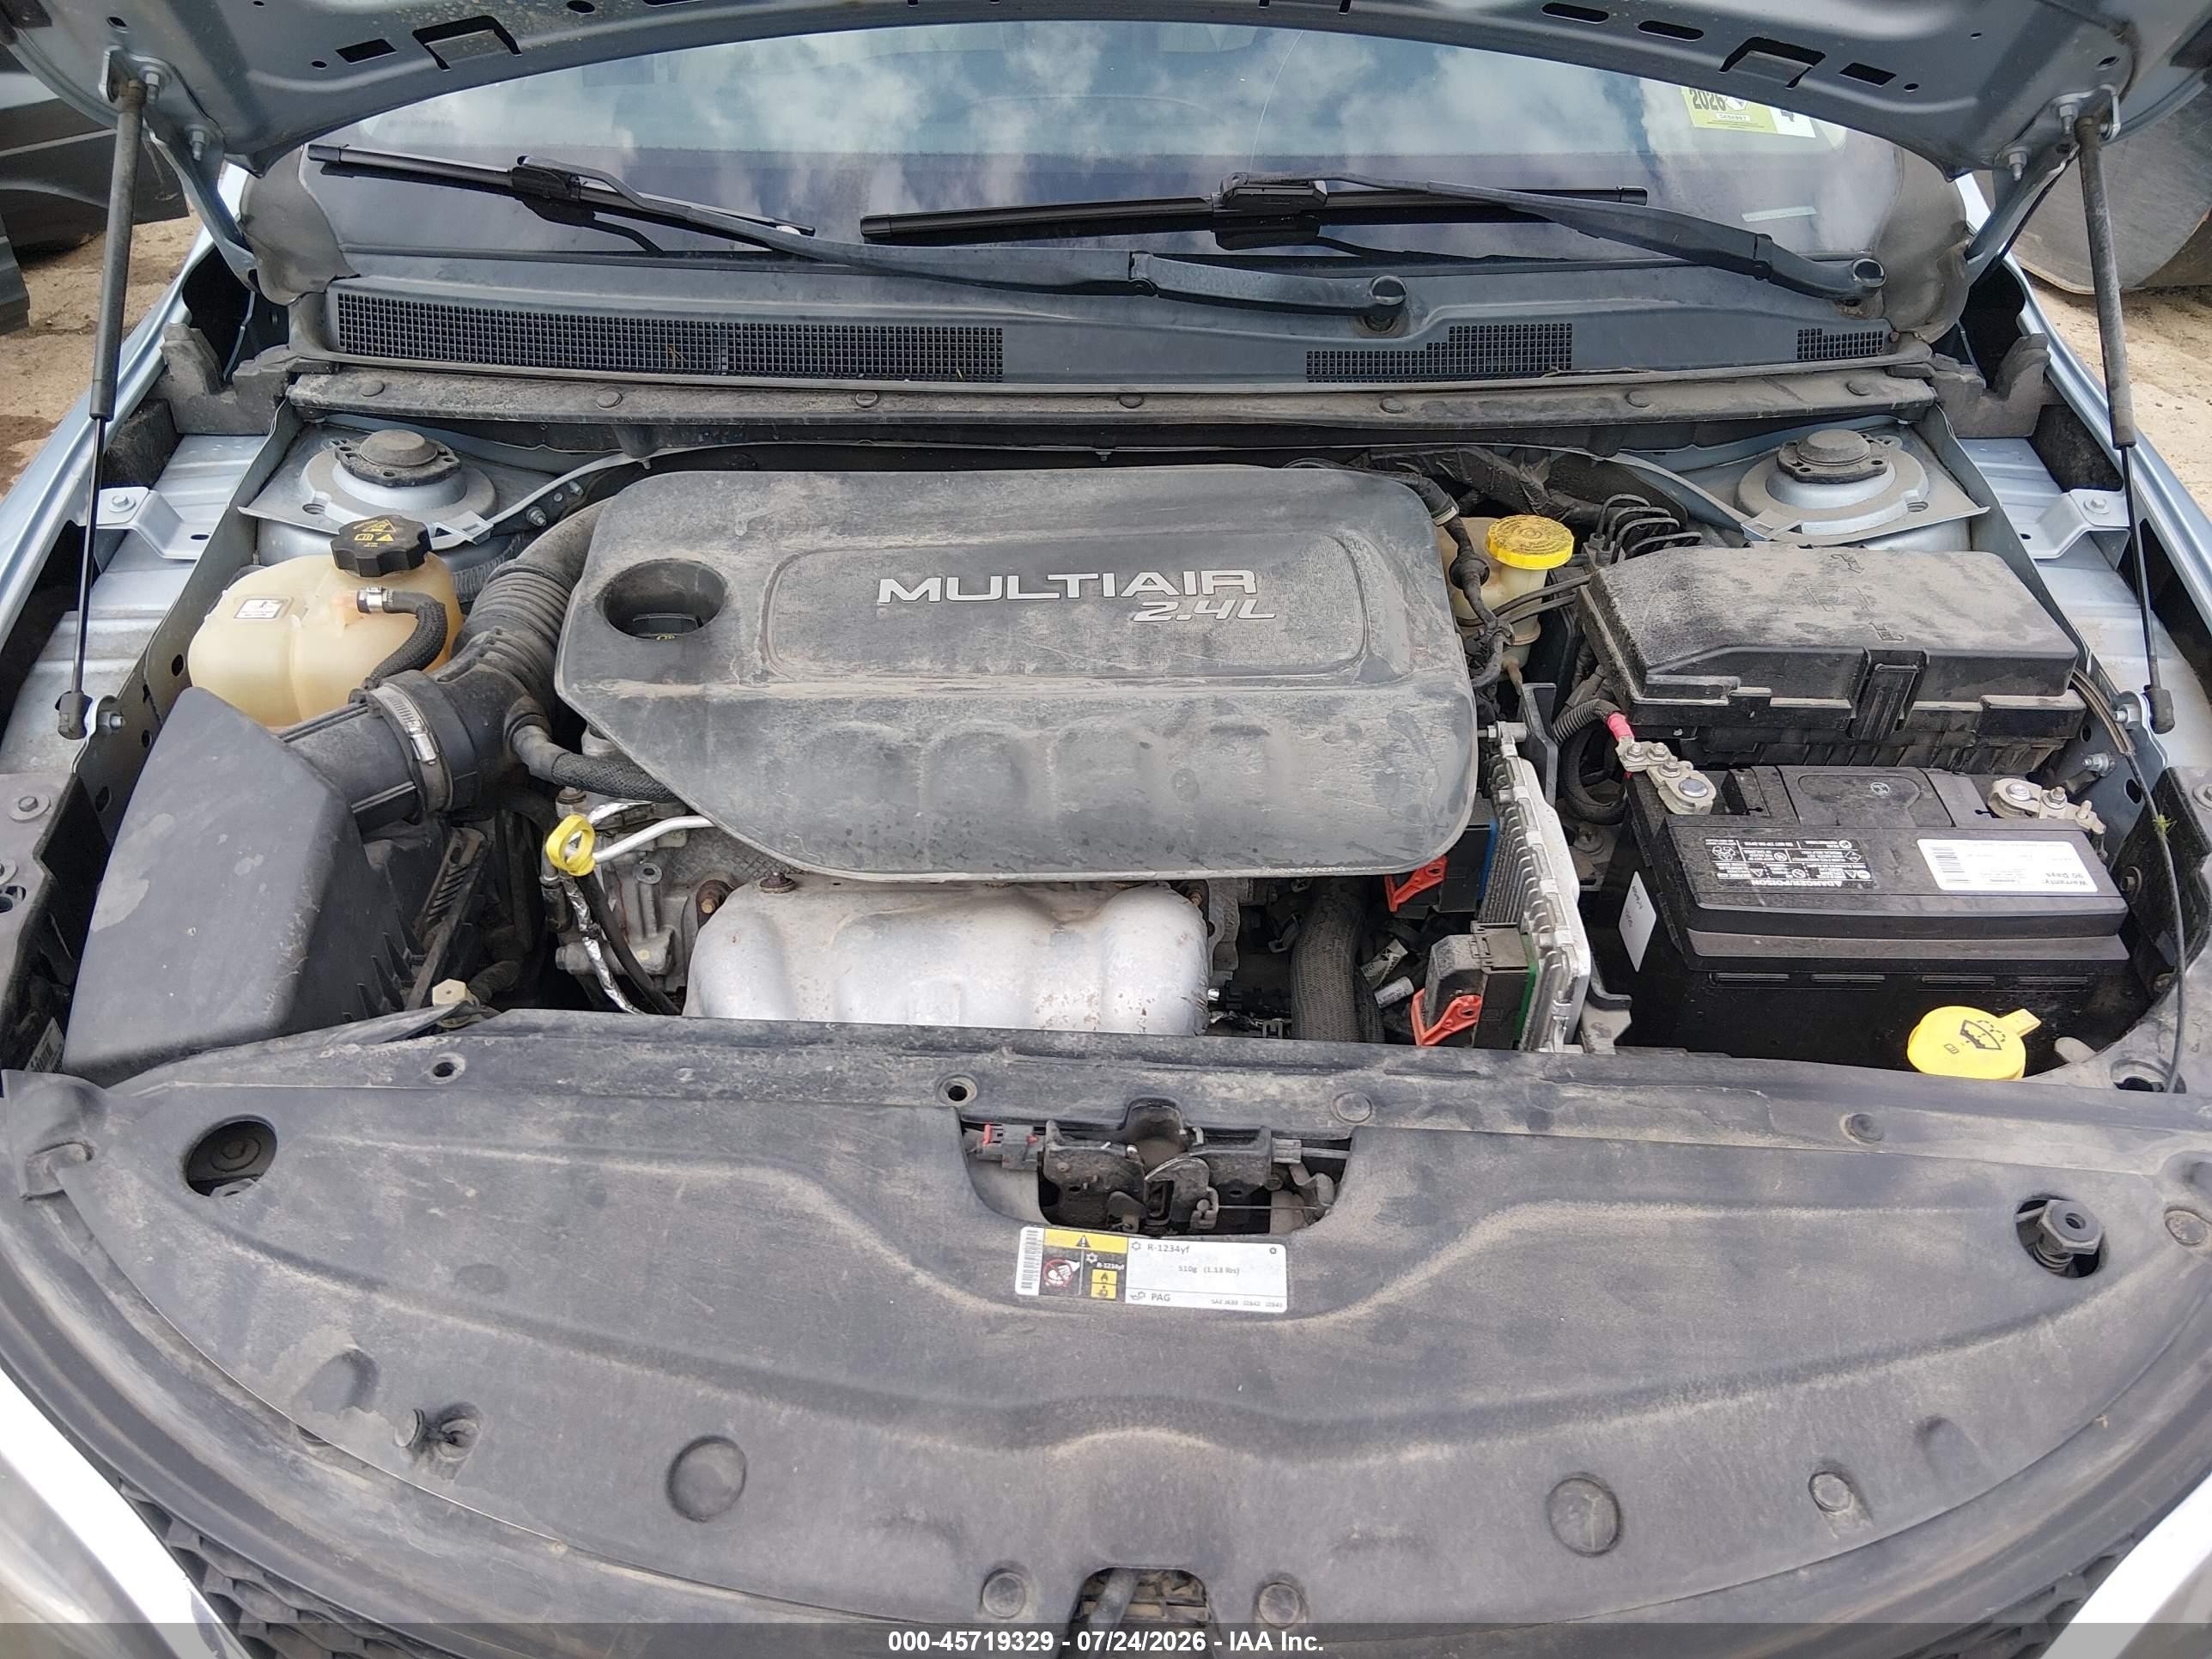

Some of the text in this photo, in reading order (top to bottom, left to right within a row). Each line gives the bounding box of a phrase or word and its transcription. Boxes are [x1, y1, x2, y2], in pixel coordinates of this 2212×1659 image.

[1689, 88, 1727, 111] 2026
[878, 570, 1257, 604] MULTIAIR
[1133, 599, 1276, 623] 2.4L
[1147, 1243, 1190, 1255] R-1234yf
[1151, 1292, 1171, 1302] PAG
